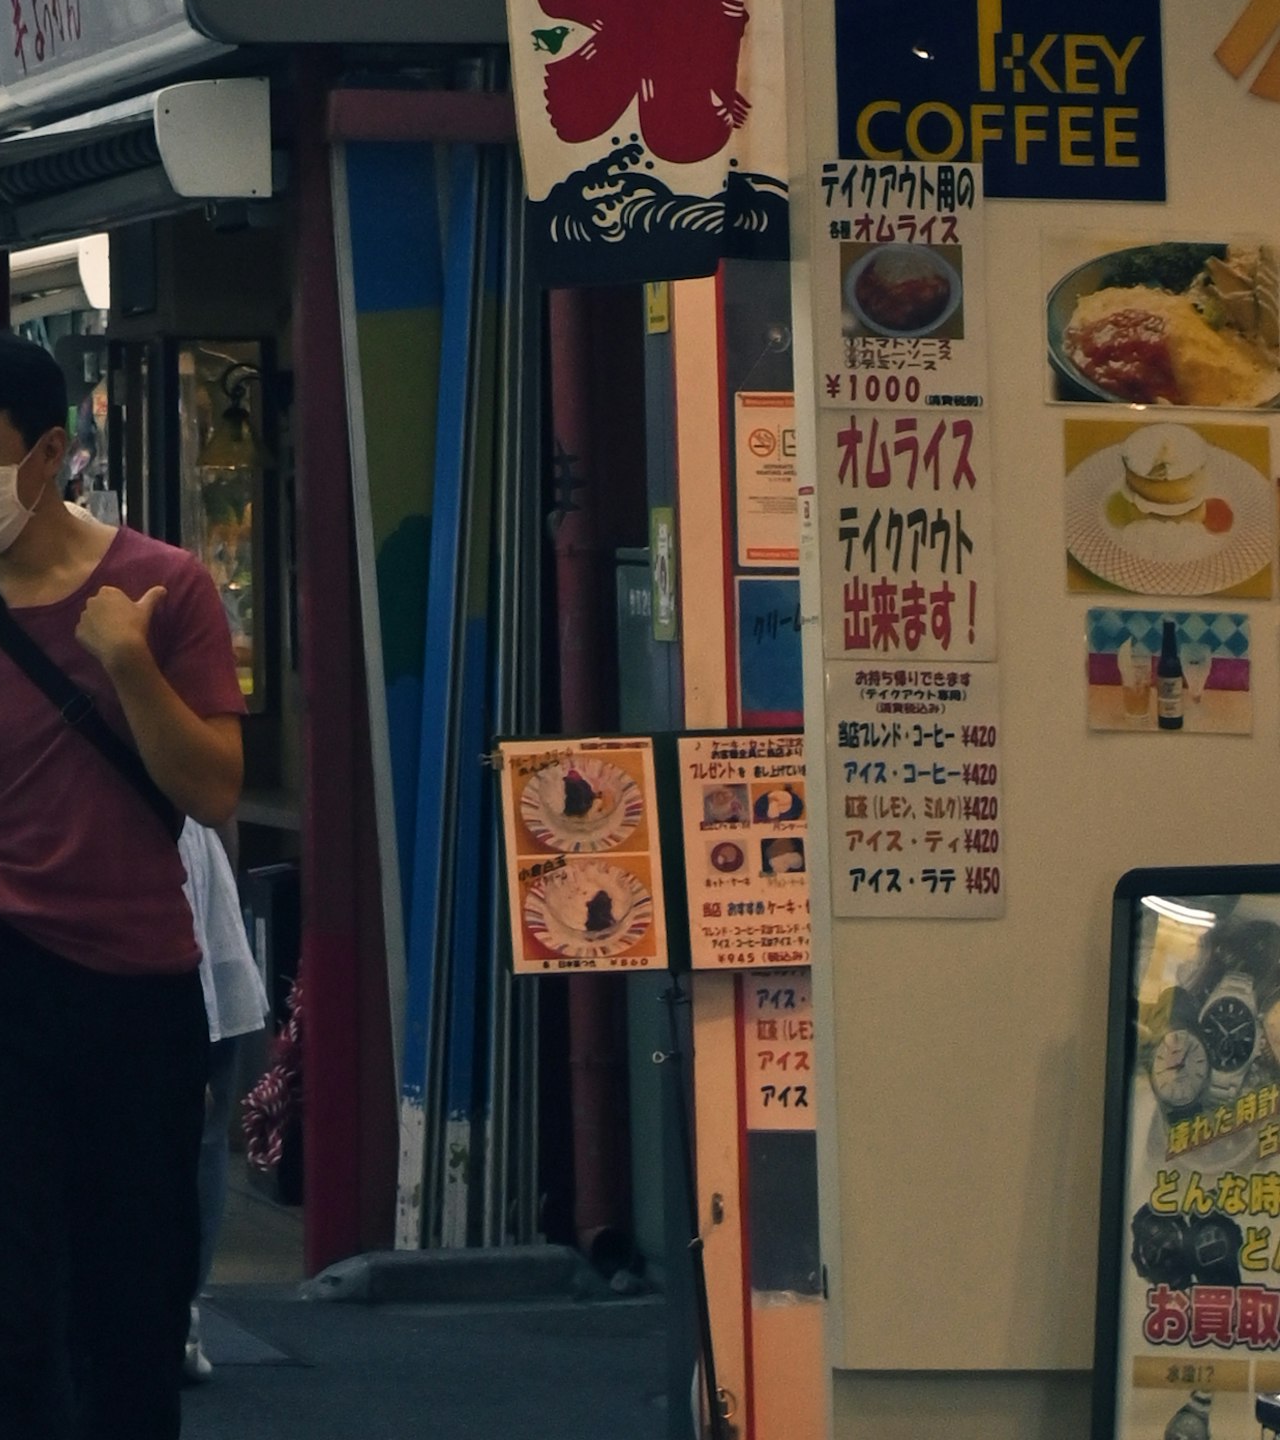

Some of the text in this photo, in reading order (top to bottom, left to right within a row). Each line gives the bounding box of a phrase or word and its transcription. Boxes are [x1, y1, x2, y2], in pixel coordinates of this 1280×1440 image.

[856, 102, 1140, 167] COFFEE
[822, 164, 974, 213] テイクアウト用の
[826, 374, 920, 403] ¥1000
[837, 415, 977, 491] オムライス
[839, 507, 974, 575] テイクアウト
[855, 671, 972, 687] お持ち帰りできます
[961, 725, 996, 748] ¥420
[844, 760, 998, 786] アイス・コーヒー ¥420
[963, 796, 998, 821] ¥420
[964, 829, 999, 854] ¥420
[850, 867, 1000, 894] アイス・ラテ ¥450
[758, 1050, 810, 1071] アイス
[761, 1085, 808, 1107] アイス
[1241, 1226, 1280, 1272] ど
